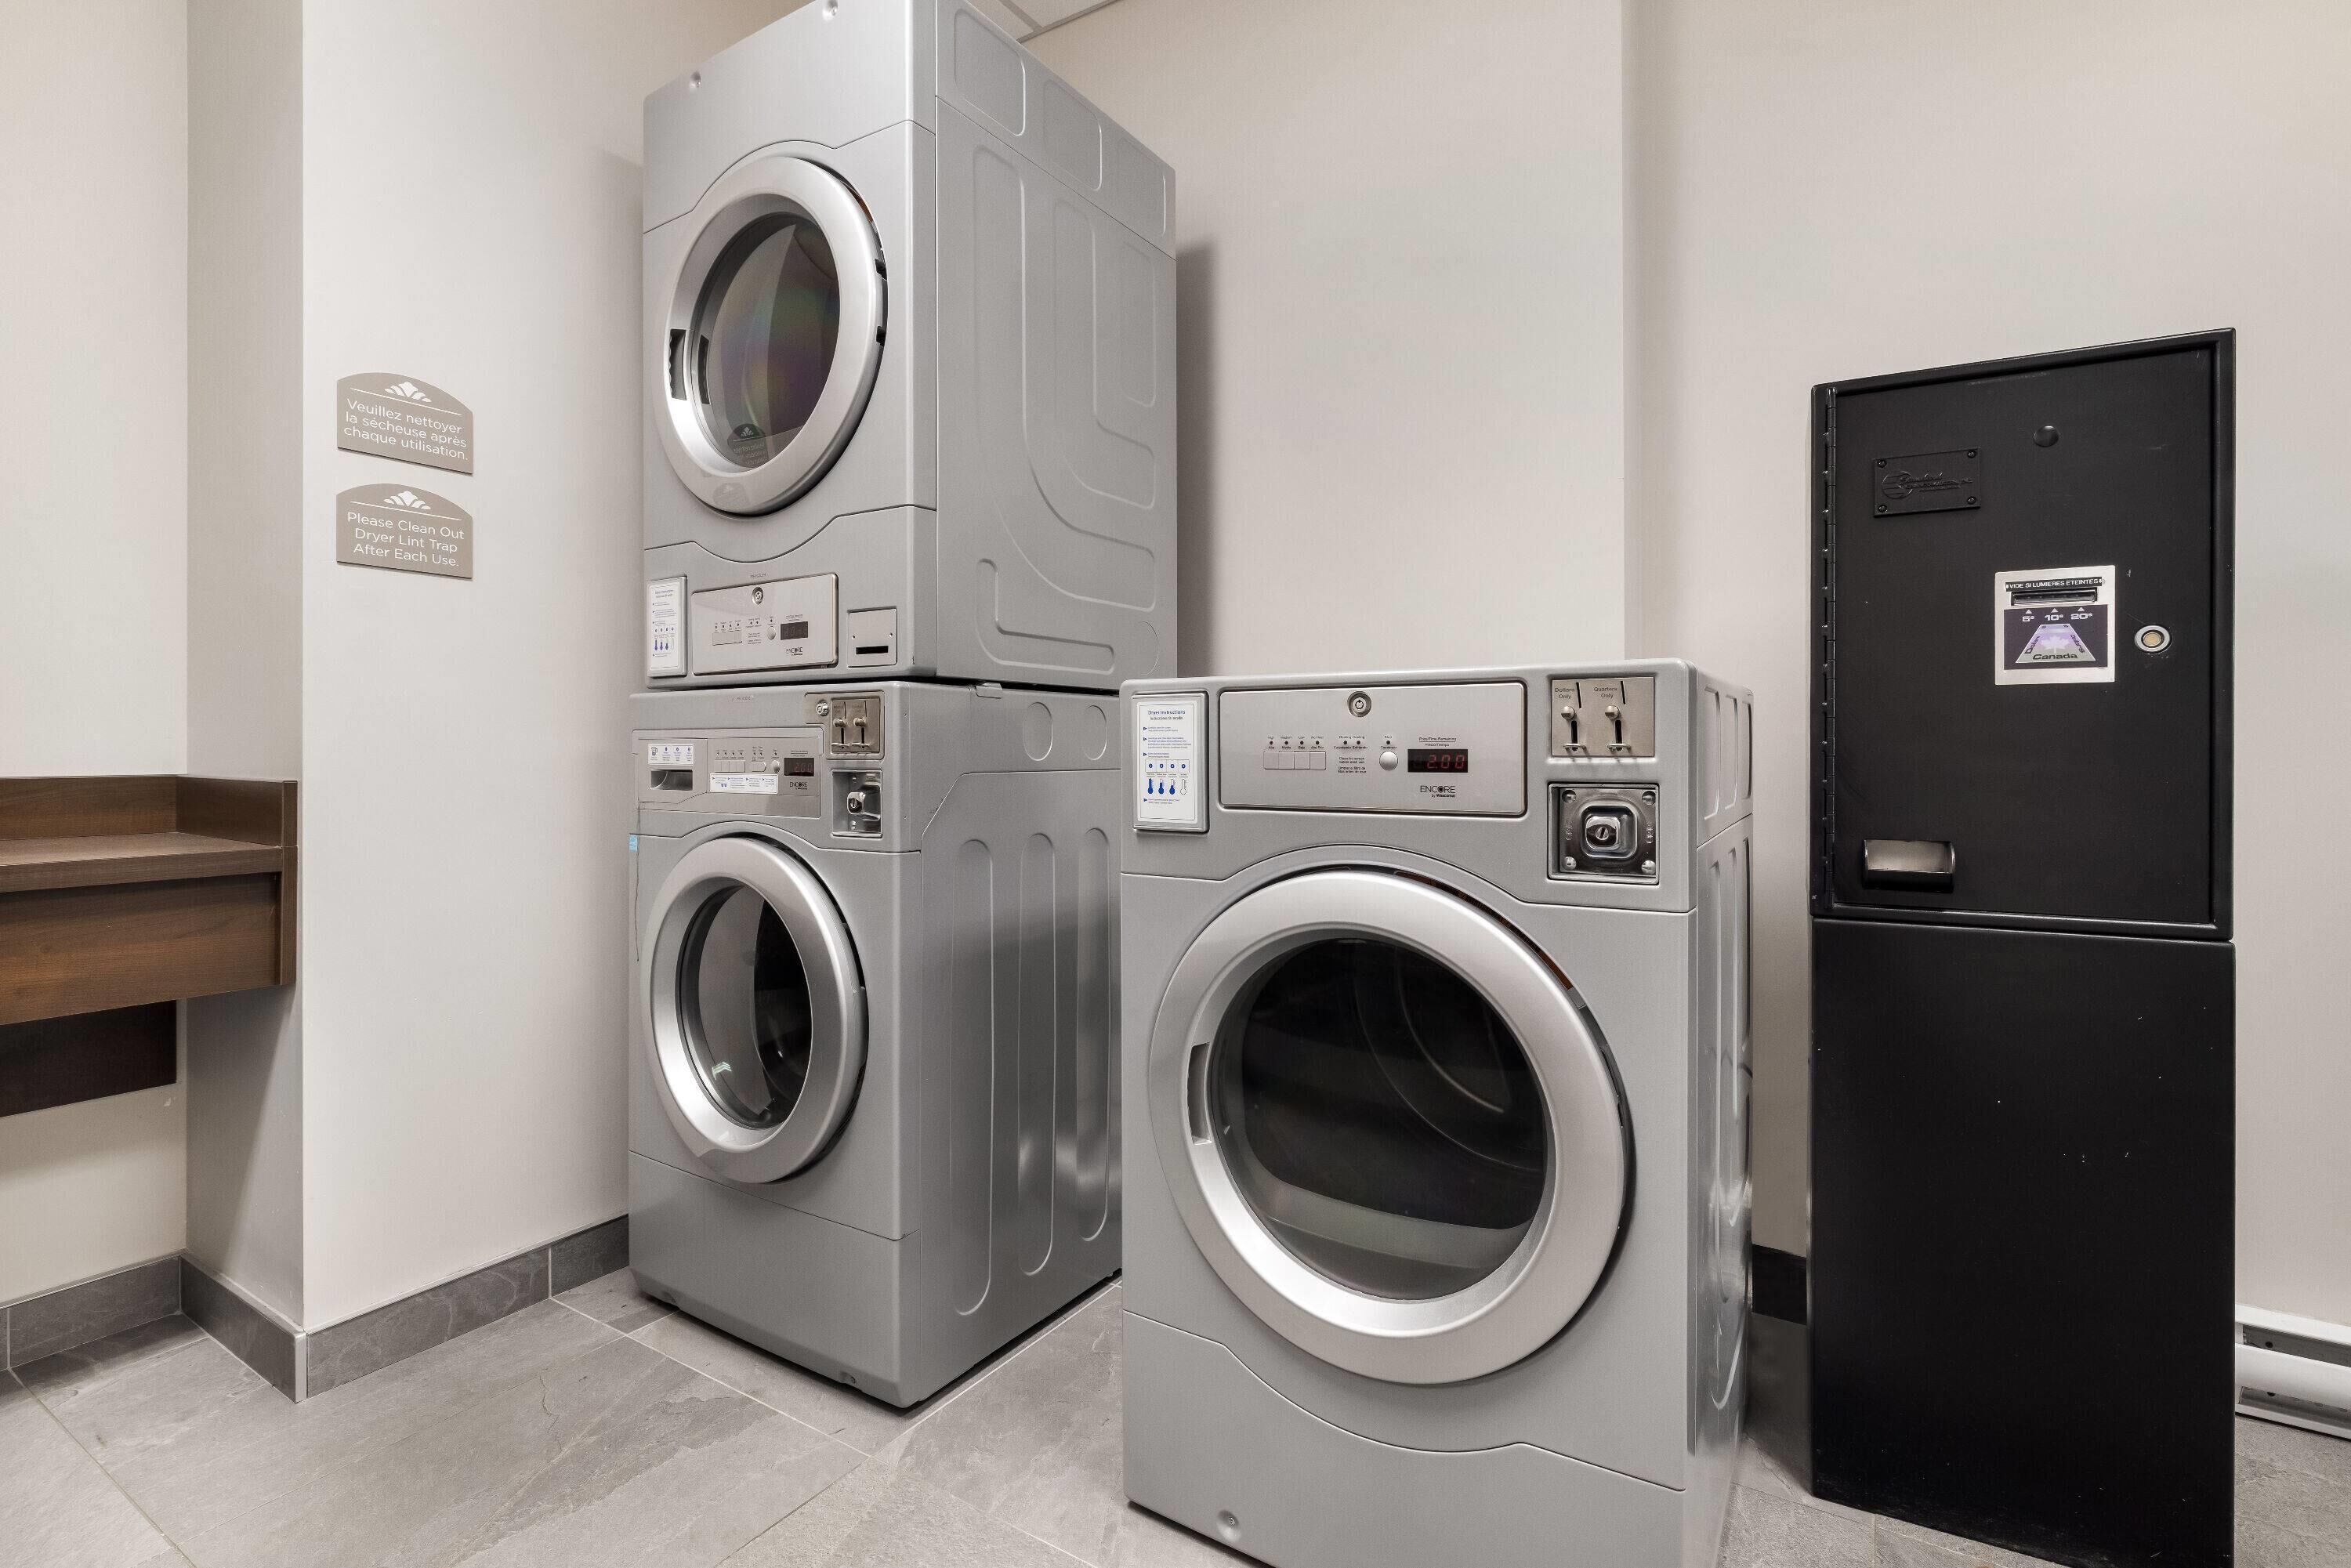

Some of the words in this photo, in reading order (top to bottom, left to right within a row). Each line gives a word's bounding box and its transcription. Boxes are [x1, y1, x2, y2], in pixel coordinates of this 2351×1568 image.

[346, 411, 357, 424] la
[363, 418, 427, 439] sécheuse
[430, 433, 467, 448] après
[347, 398, 401, 421] Veuillez
[406, 414, 462, 434] nettoyer
[344, 427, 397, 445] chaque
[401, 439, 469, 461] utilisation.
[347, 512, 393, 528] Please
[398, 520, 436, 534] Clean
[440, 527, 465, 540] Out
[355, 528, 395, 546] Dryer
[399, 534, 425, 548] Lint
[429, 539, 458, 553] Trap
[353, 543, 390, 557] After
[394, 549, 427, 563] Each
[432, 553, 459, 567] Use.
[1419, 785, 1456, 794] ENCORE
